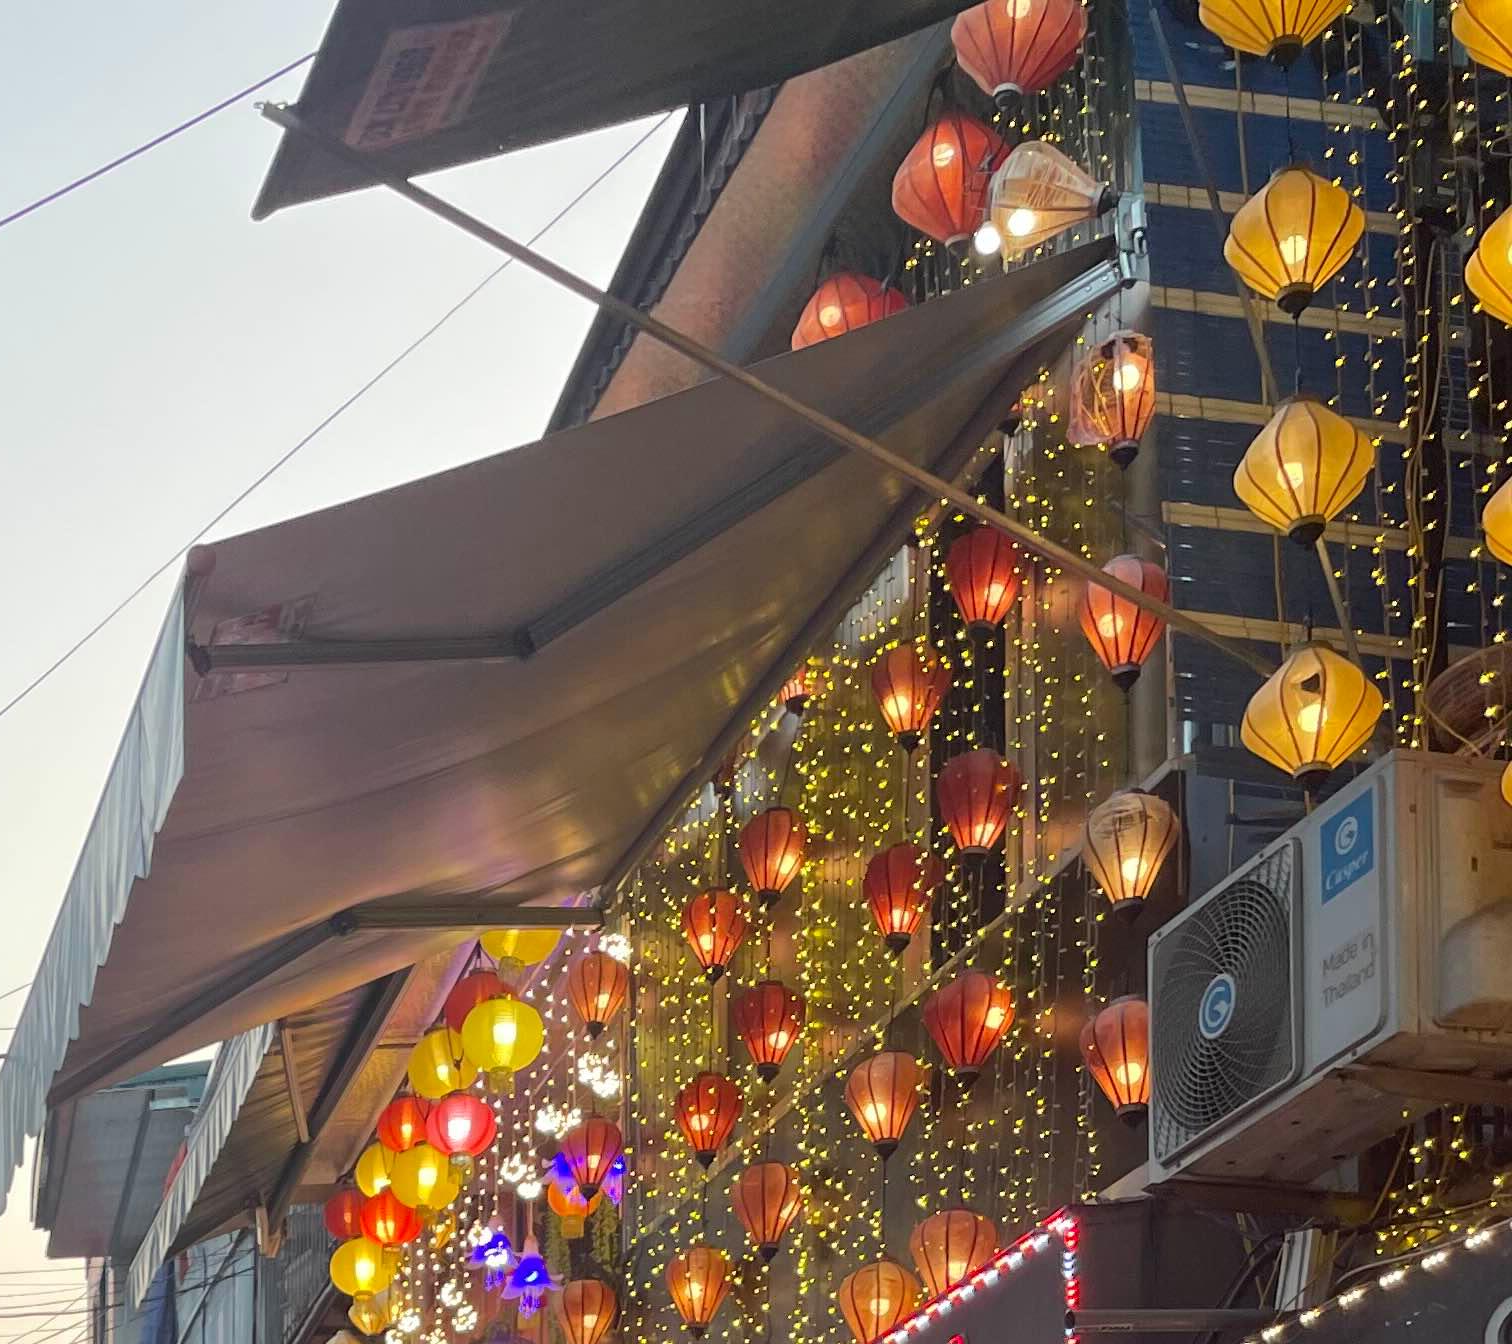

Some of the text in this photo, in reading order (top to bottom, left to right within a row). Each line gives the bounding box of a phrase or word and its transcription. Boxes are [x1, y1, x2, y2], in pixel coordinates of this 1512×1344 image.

[1325, 850, 1369, 891] Casper
[1322, 942, 1358, 977] Made
[1322, 951, 1376, 1009] Thailand
